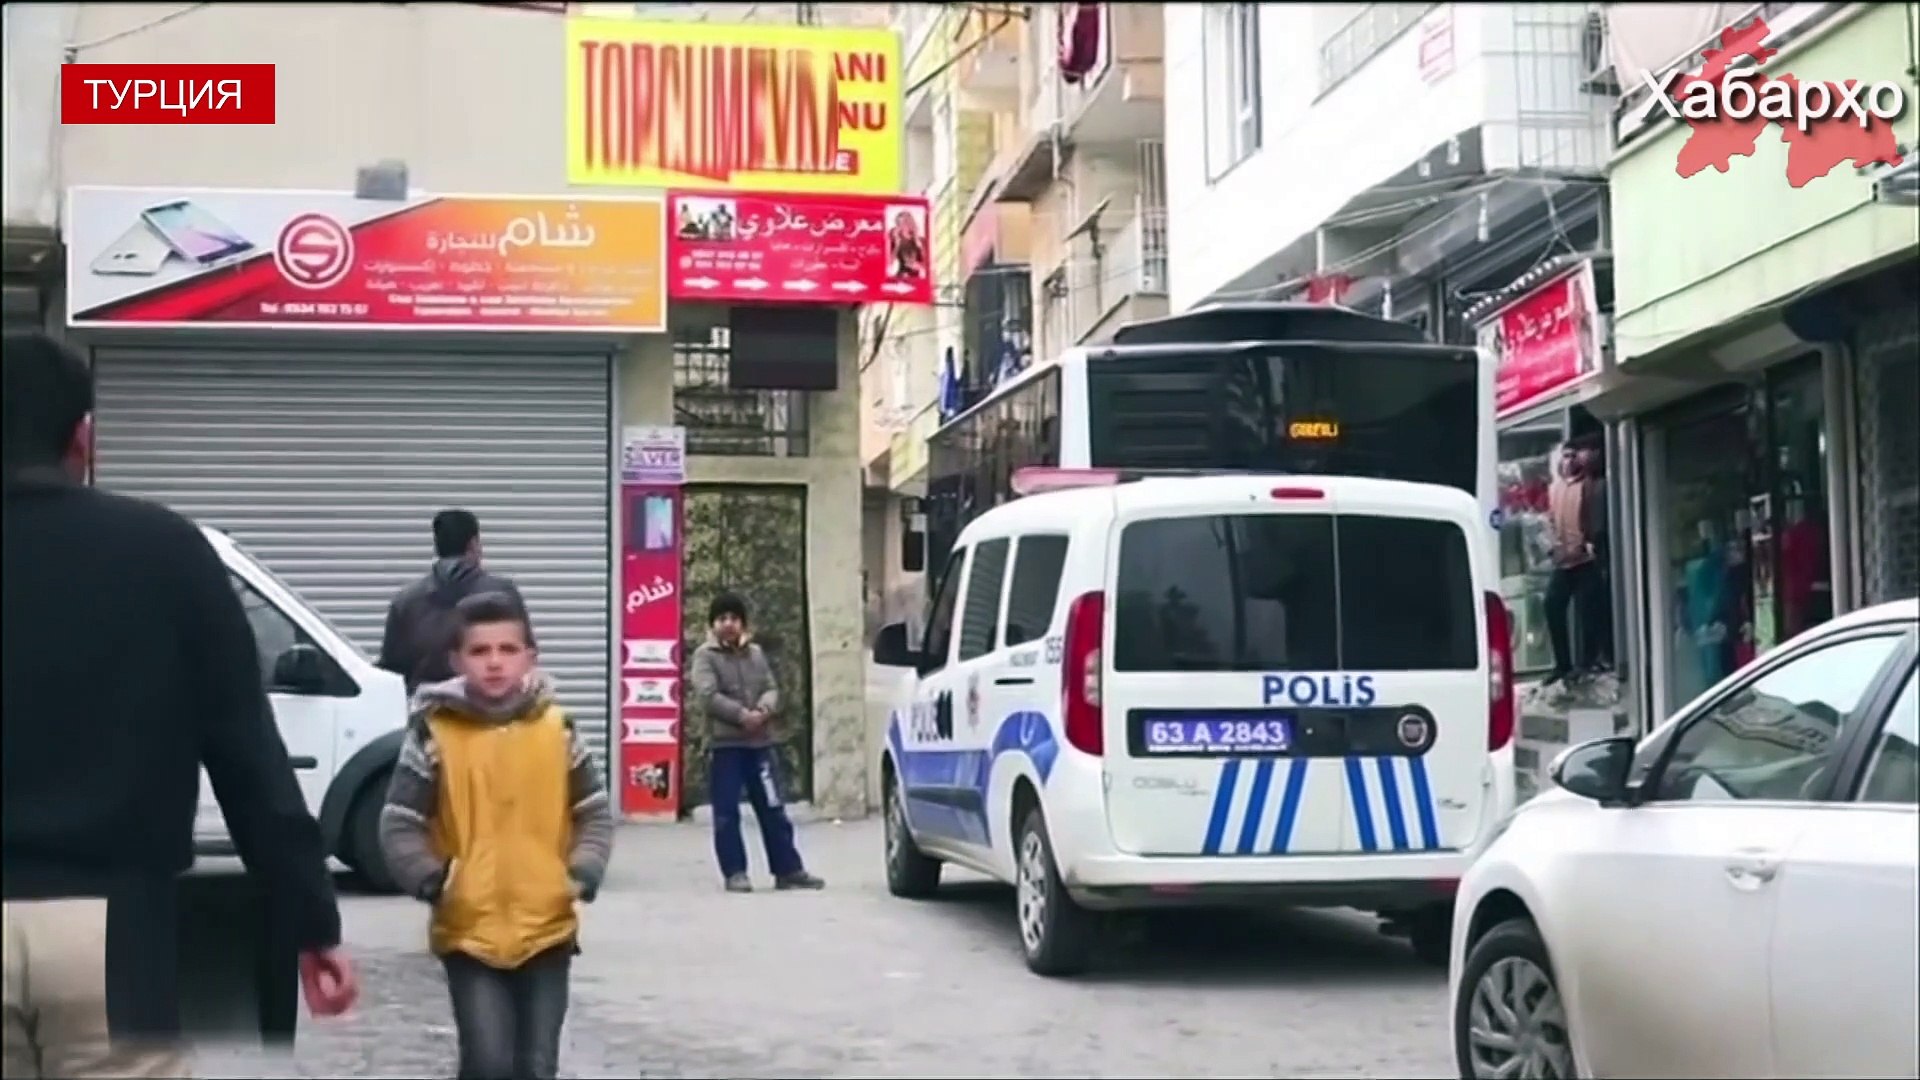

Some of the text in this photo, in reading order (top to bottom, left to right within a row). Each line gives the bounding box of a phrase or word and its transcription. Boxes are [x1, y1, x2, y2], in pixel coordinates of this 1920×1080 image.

[499, 204, 595, 256] شام
[1152, 722, 1285, 743] 63 A 2843
